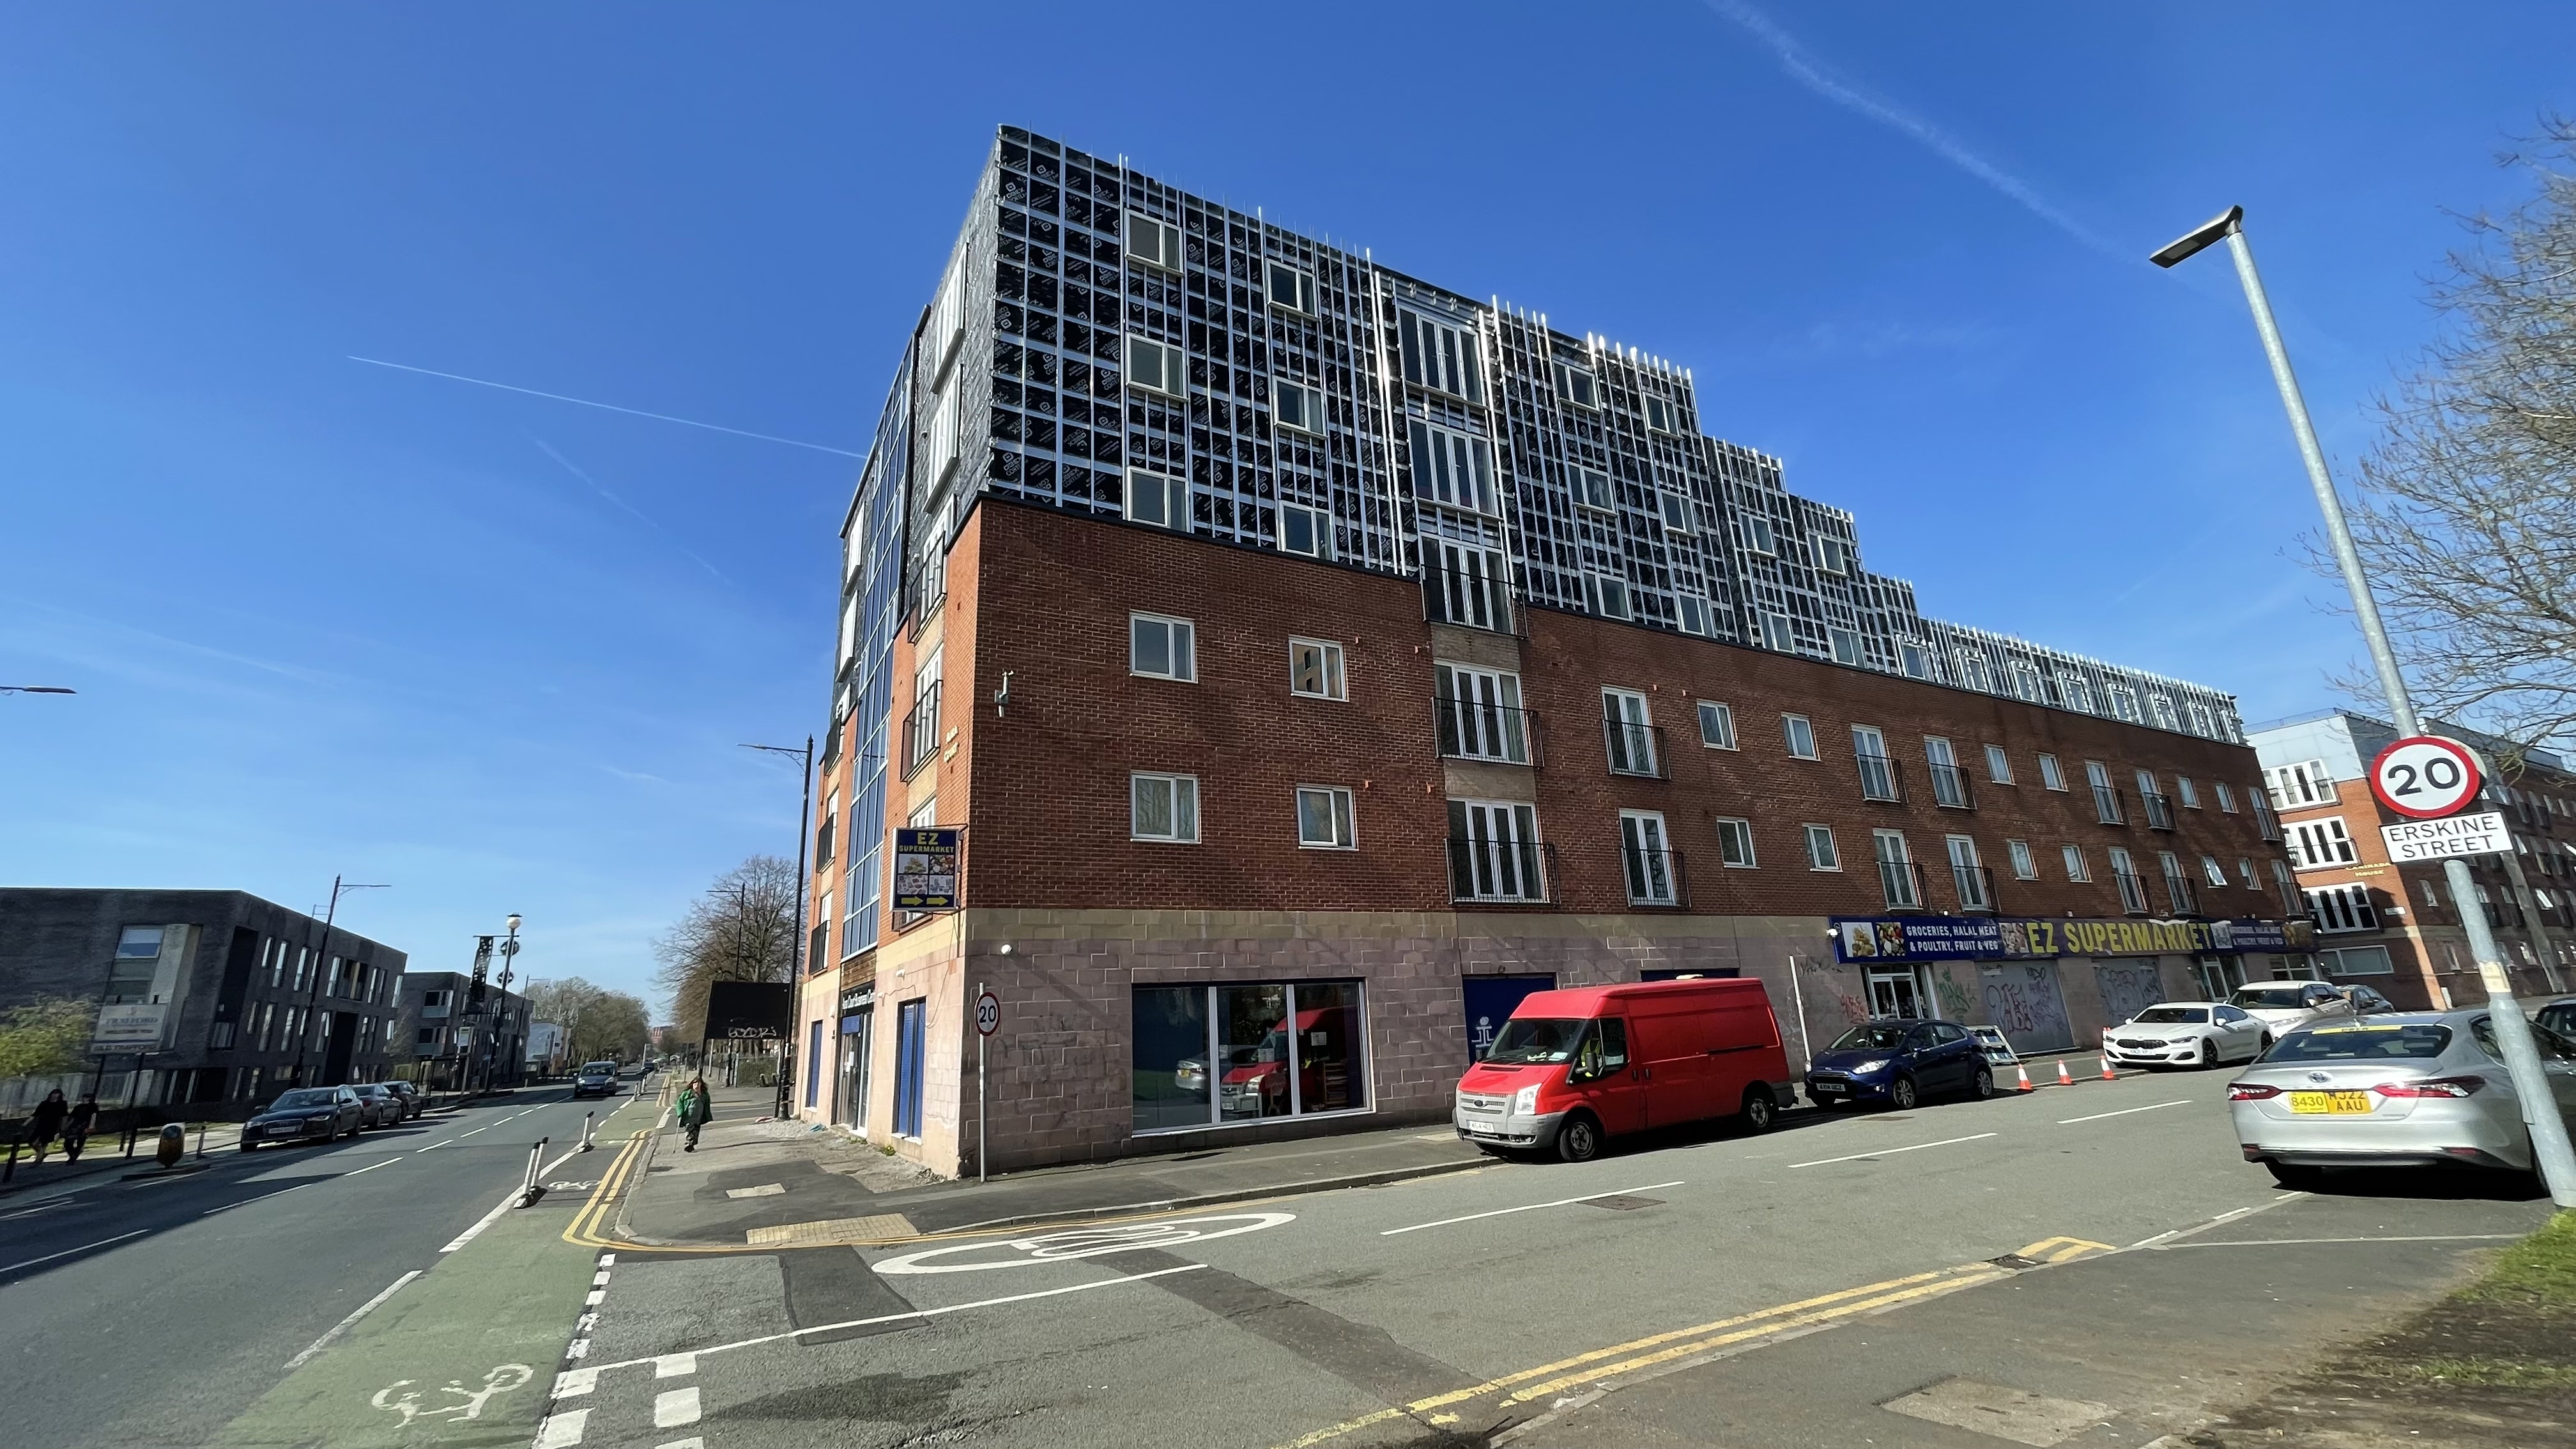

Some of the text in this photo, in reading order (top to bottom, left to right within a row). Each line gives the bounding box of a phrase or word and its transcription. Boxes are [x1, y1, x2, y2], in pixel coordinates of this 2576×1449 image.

[2388, 757, 2460, 797] 20
[2389, 816, 2498, 842] ERSKINE
[917, 832, 939, 845] EZ
[898, 845, 954, 853] SUPERMARKET
[2401, 834, 2493, 859] STREET
[1906, 926, 1997, 937] GROCERIES, HALAL MEAT
[2026, 921, 2212, 953] EZ SUPERMARKET
[1910, 941, 1916, 951] &
[1917, 941, 1954, 952] POULTRY,
[1955, 941, 1976, 951] FRUIT
[1984, 940, 1998, 950] VEG
[979, 1005, 997, 1023] 20
[2291, 1096, 2324, 1107] 8430
[2336, 1100, 2363, 1112] AAU
